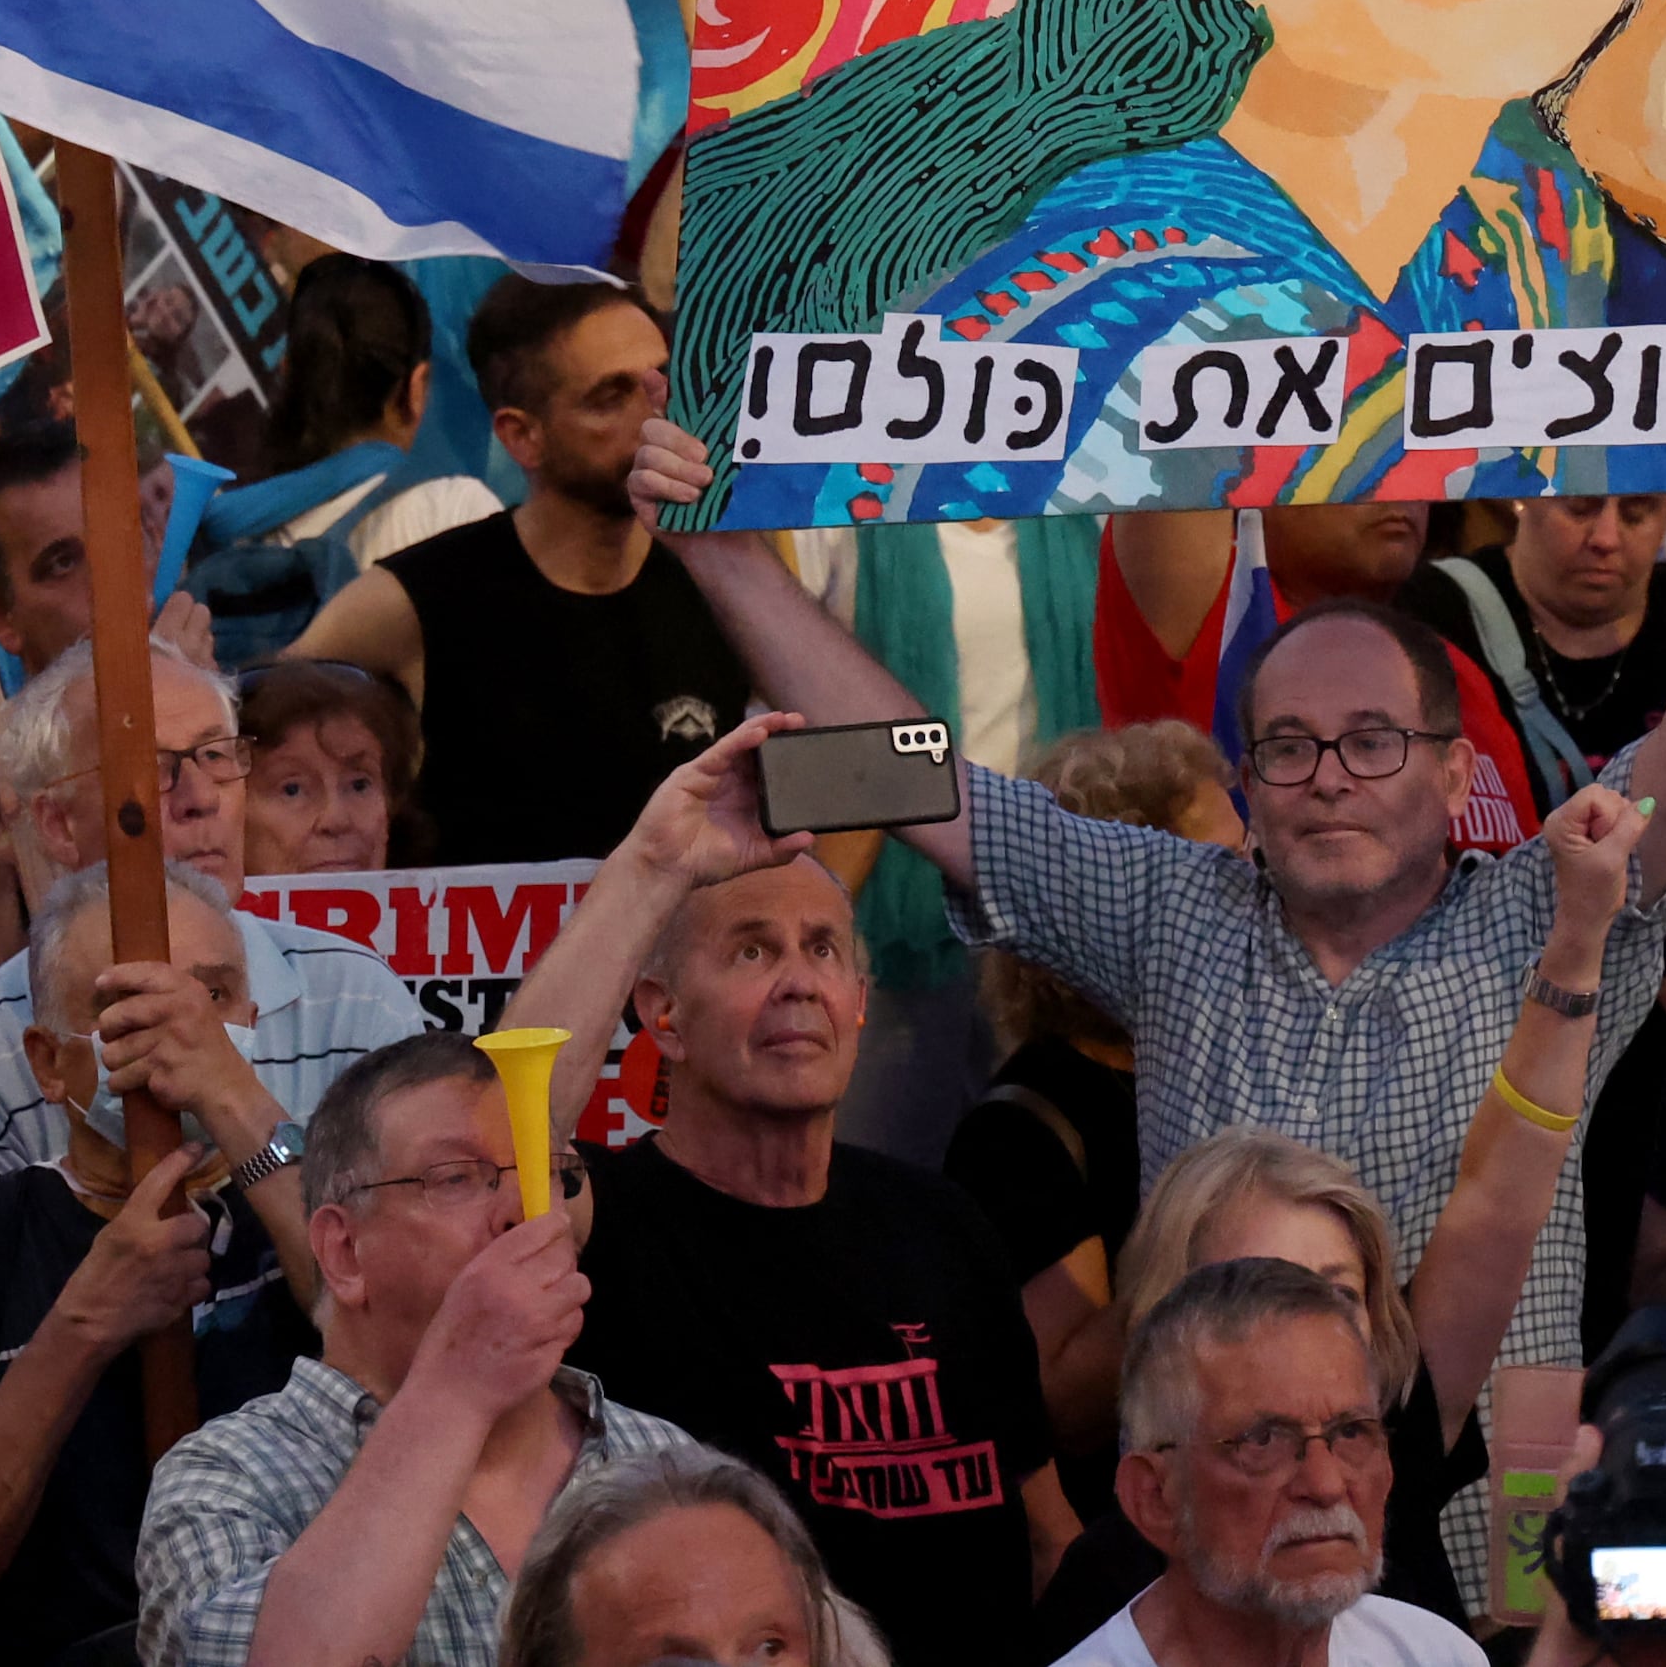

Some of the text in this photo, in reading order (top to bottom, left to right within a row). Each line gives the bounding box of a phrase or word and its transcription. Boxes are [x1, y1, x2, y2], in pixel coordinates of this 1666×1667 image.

[739, 319, 1066, 462] כולם!
[1145, 339, 1340, 445] את
[233, 882, 595, 976] RIM
